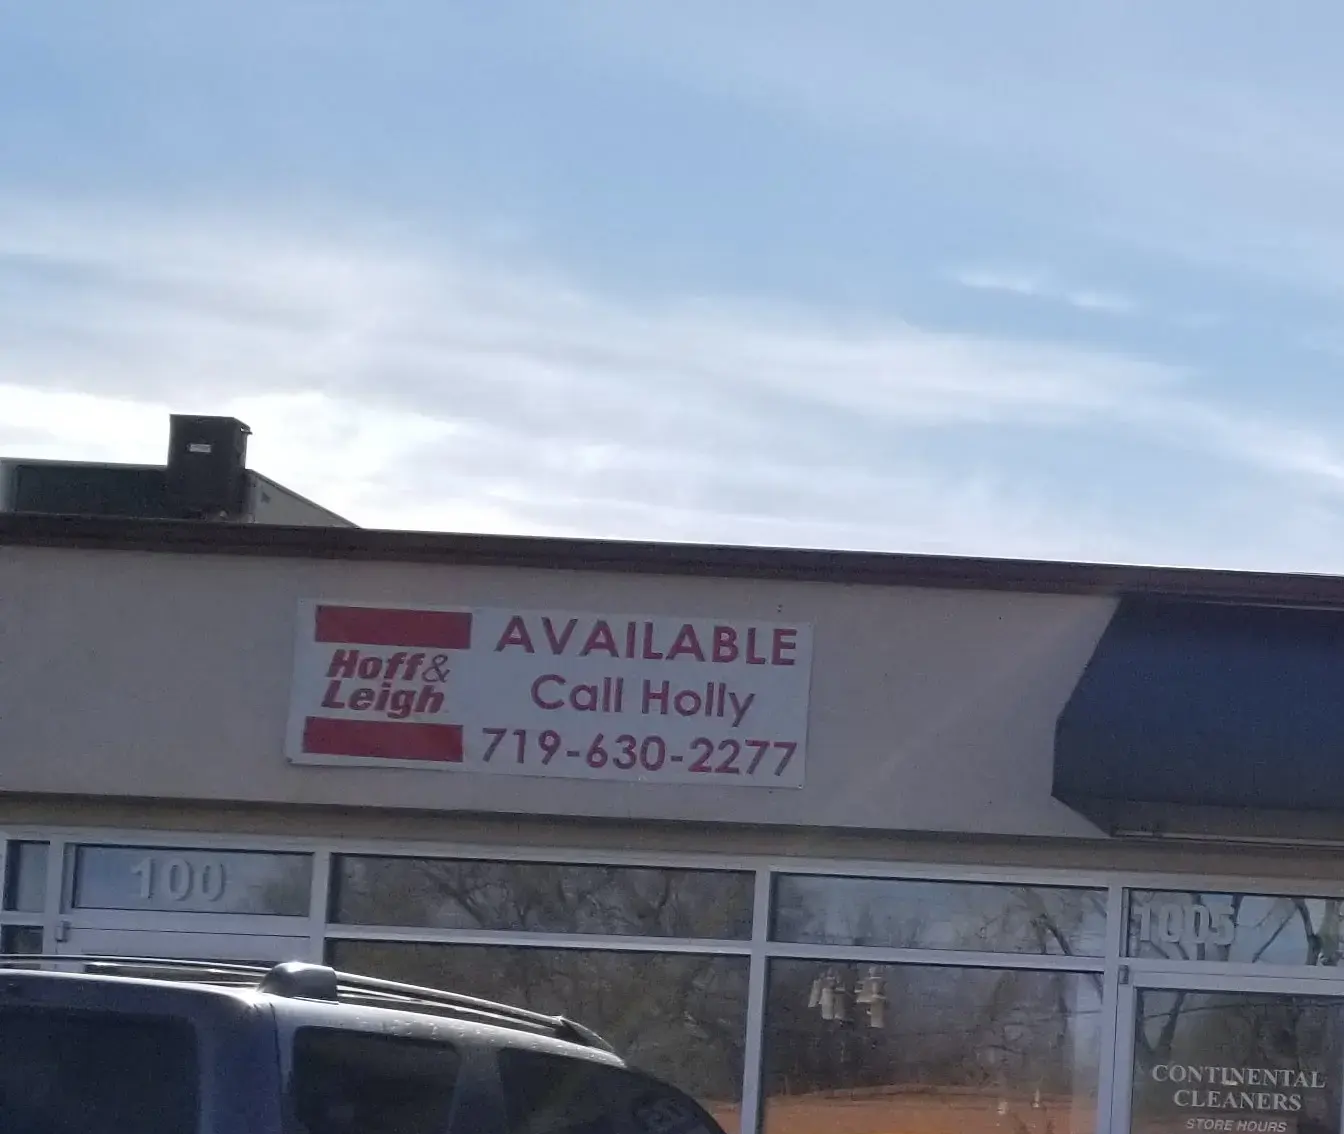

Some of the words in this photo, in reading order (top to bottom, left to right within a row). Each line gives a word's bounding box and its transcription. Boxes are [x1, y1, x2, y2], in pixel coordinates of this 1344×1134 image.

[495, 614, 798, 666] AVAILABLE
[321, 680, 446, 719] Leigh
[530, 673, 624, 714] Call
[641, 679, 756, 728] Holly
[482, 727, 799, 778] 719-630-2277
[1132, 901, 1237, 945] 1005
[1151, 1063, 1327, 1089] CONTINENTAL
[1173, 1089, 1302, 1112] CLEANERS
[1186, 1118, 1233, 1132] STORE
[1236, 1119, 1288, 1133] HOURS
